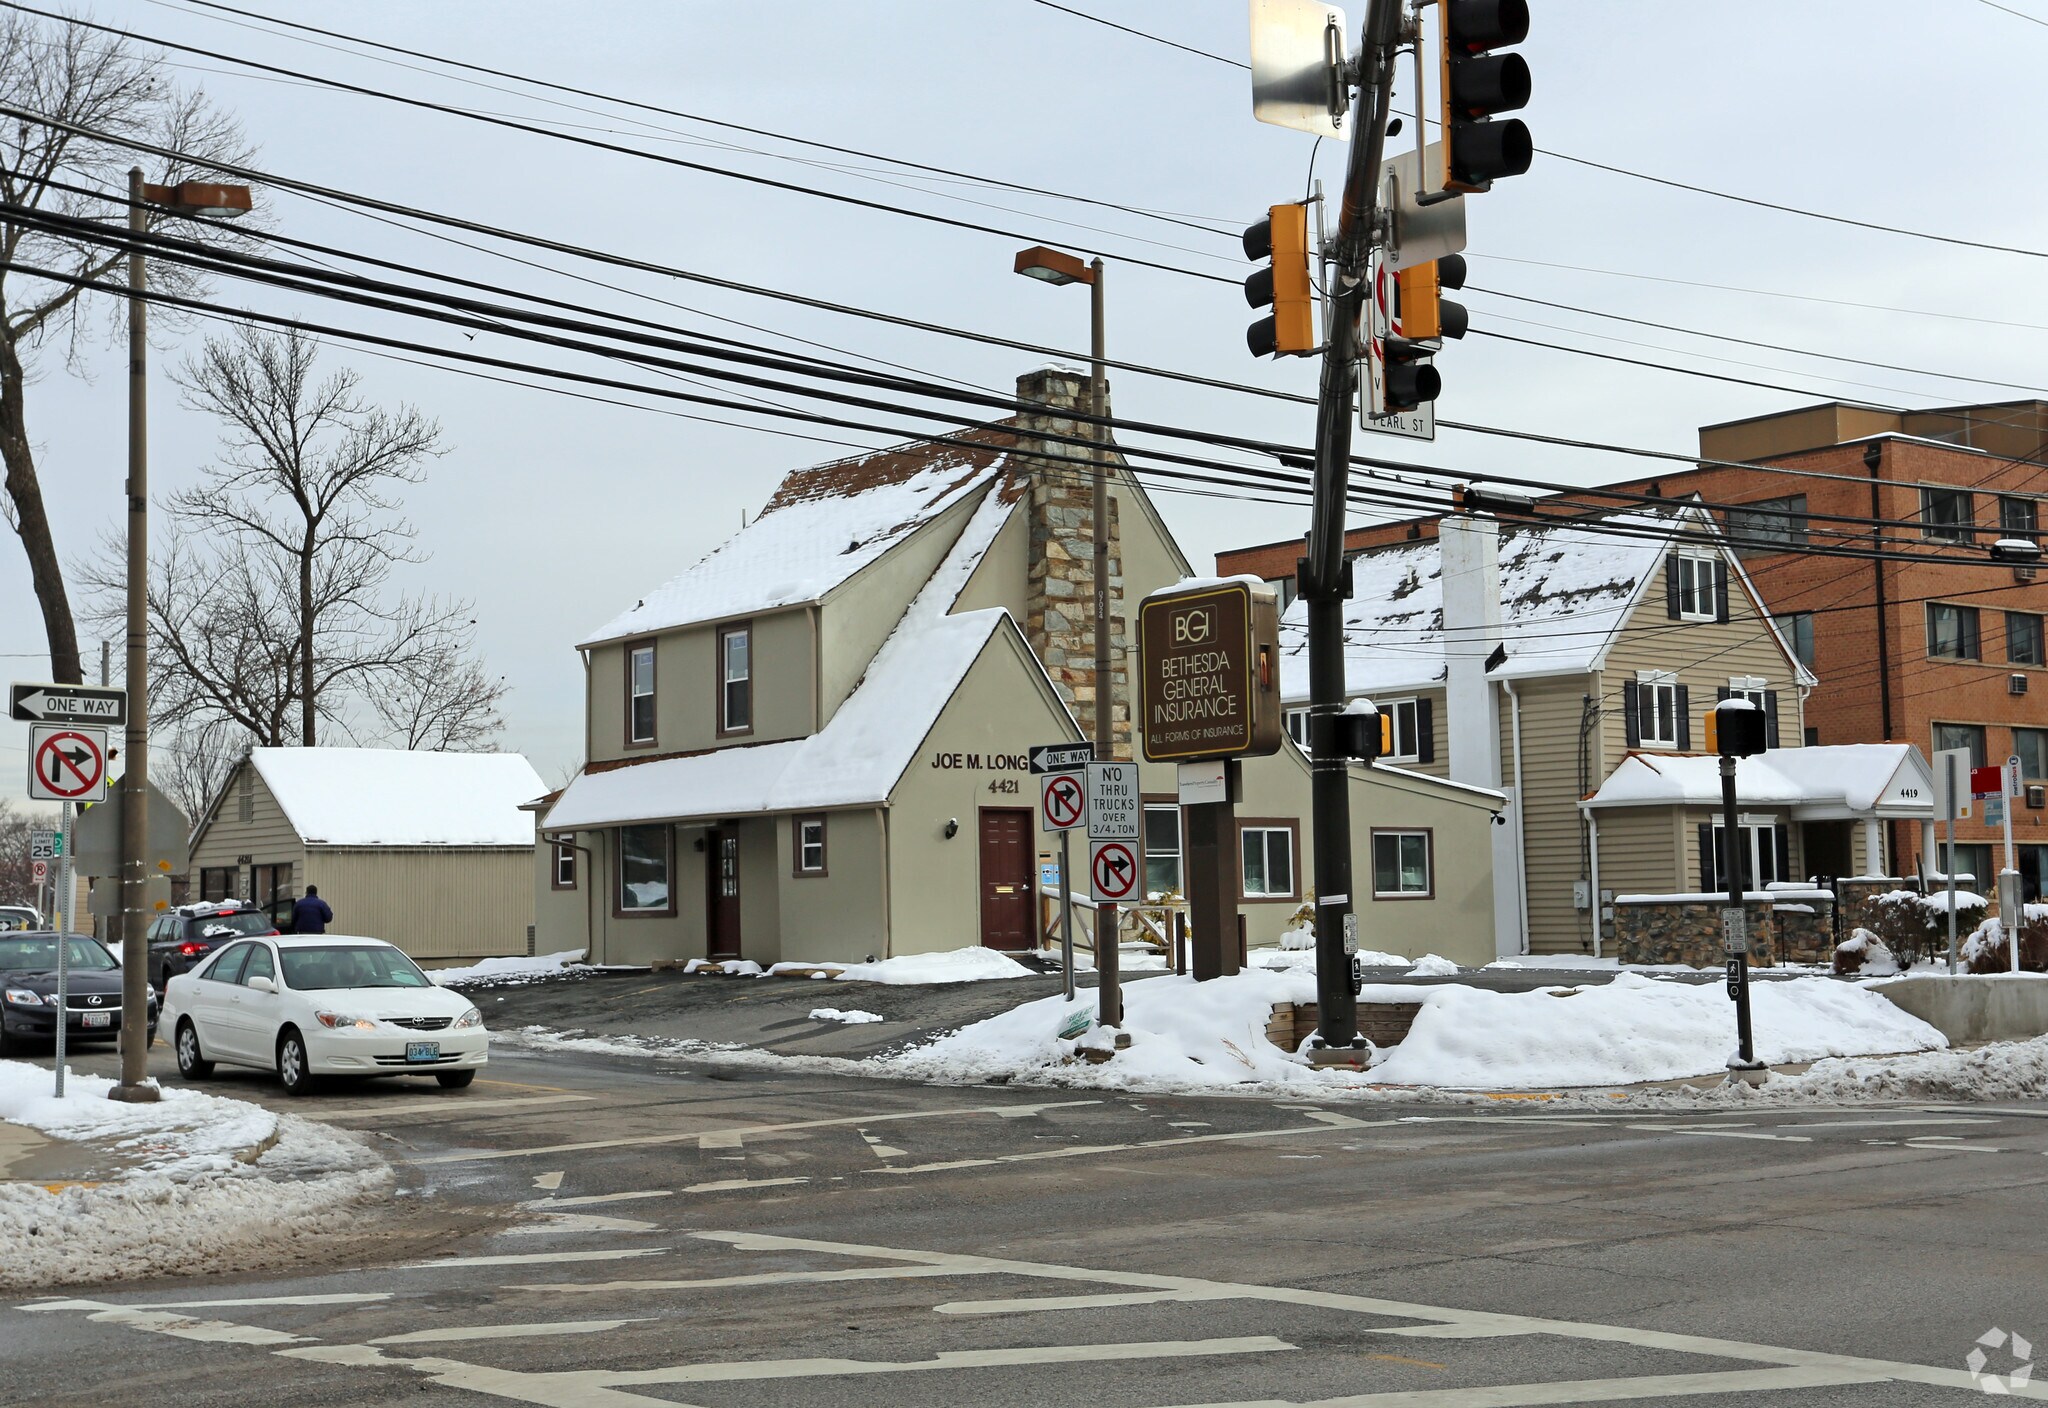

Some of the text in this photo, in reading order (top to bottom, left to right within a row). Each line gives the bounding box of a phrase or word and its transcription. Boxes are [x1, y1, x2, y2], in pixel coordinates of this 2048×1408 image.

[1413, 418, 1424, 432] ST
[1176, 610, 1208, 642] BGI
[1162, 651, 1230, 678] BETHESDA
[1163, 674, 1227, 700] GENERAL
[47, 698, 114, 714] ONE WAY
[1154, 695, 1236, 724] INSURANCE
[1151, 724, 1243, 744] ALL FORMS OF INSURANCE
[932, 753, 1028, 770] JOE M. LONG
[1046, 751, 1089, 764] ONE WAY
[1102, 768, 1122, 781] NO
[988, 779, 1019, 793] 4421
[1100, 785, 1128, 796] THRU
[1901, 788, 1918, 798] 4419
[1094, 799, 1134, 810] TRUCKS
[1102, 813, 1126, 822] OVER
[33, 846, 52, 856] 25
